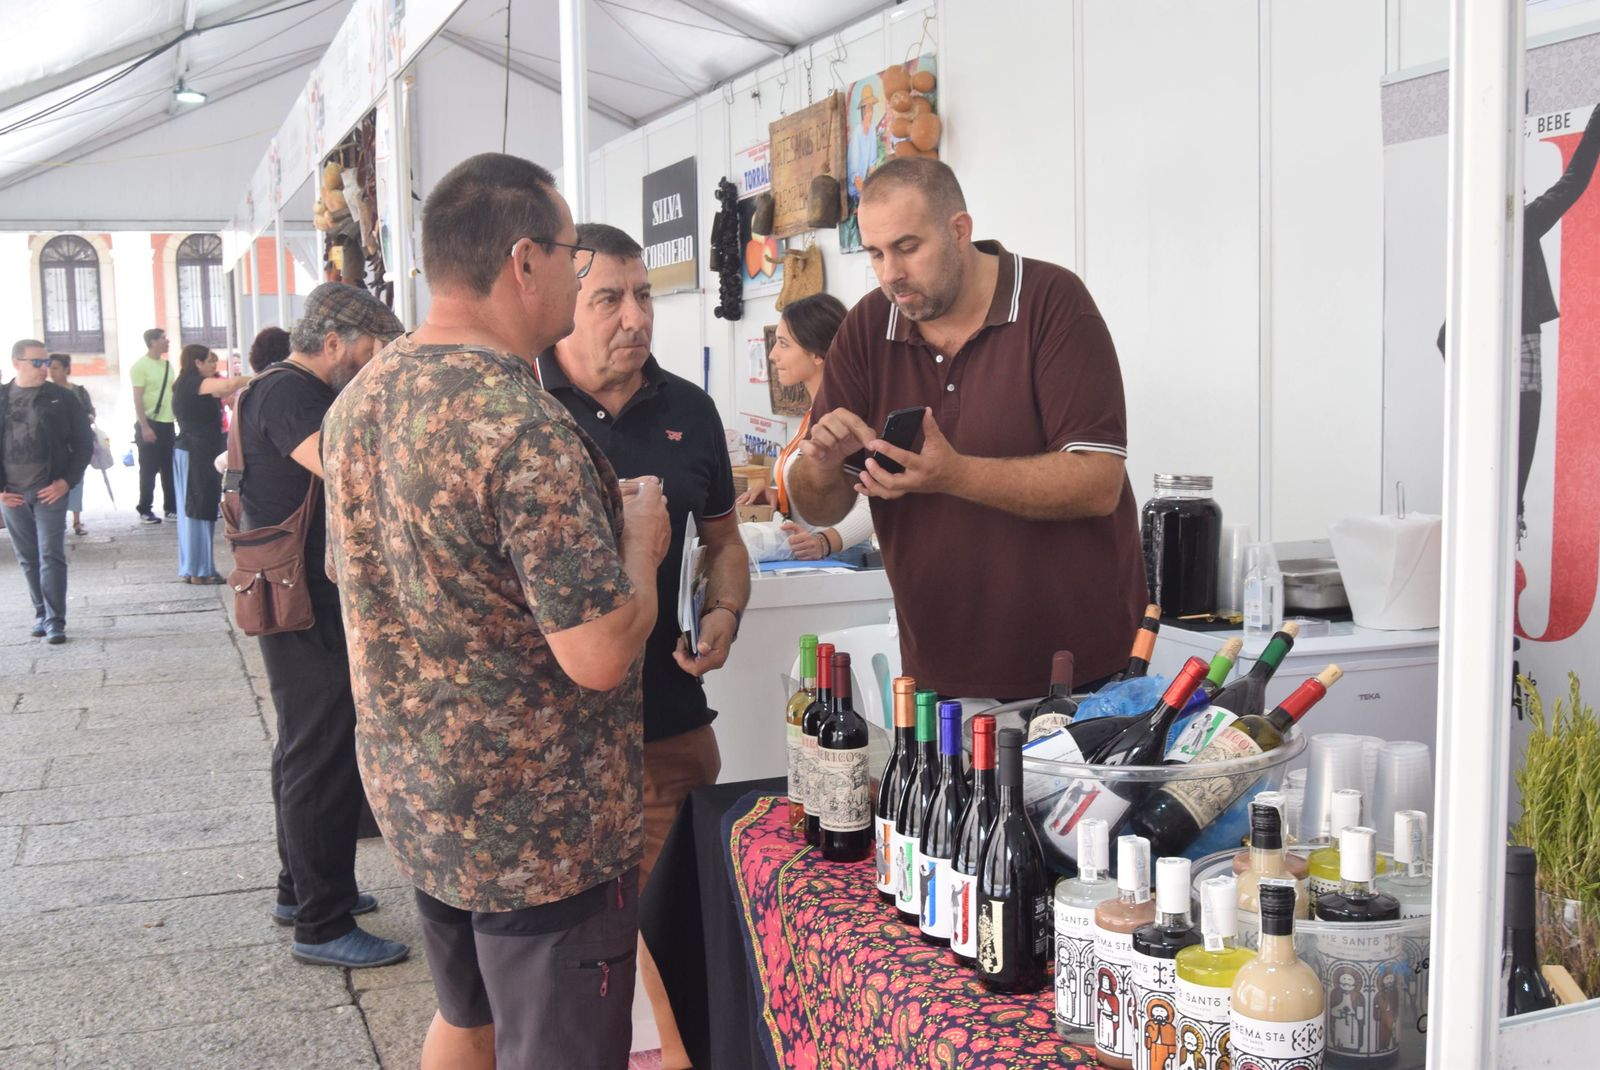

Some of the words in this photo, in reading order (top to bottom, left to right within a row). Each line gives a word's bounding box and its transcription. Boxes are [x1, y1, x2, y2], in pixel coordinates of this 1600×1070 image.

[1537, 111, 1572, 133] BEBE
[744, 162, 771, 191] TORRAL
[652, 192, 683, 226] SILVA
